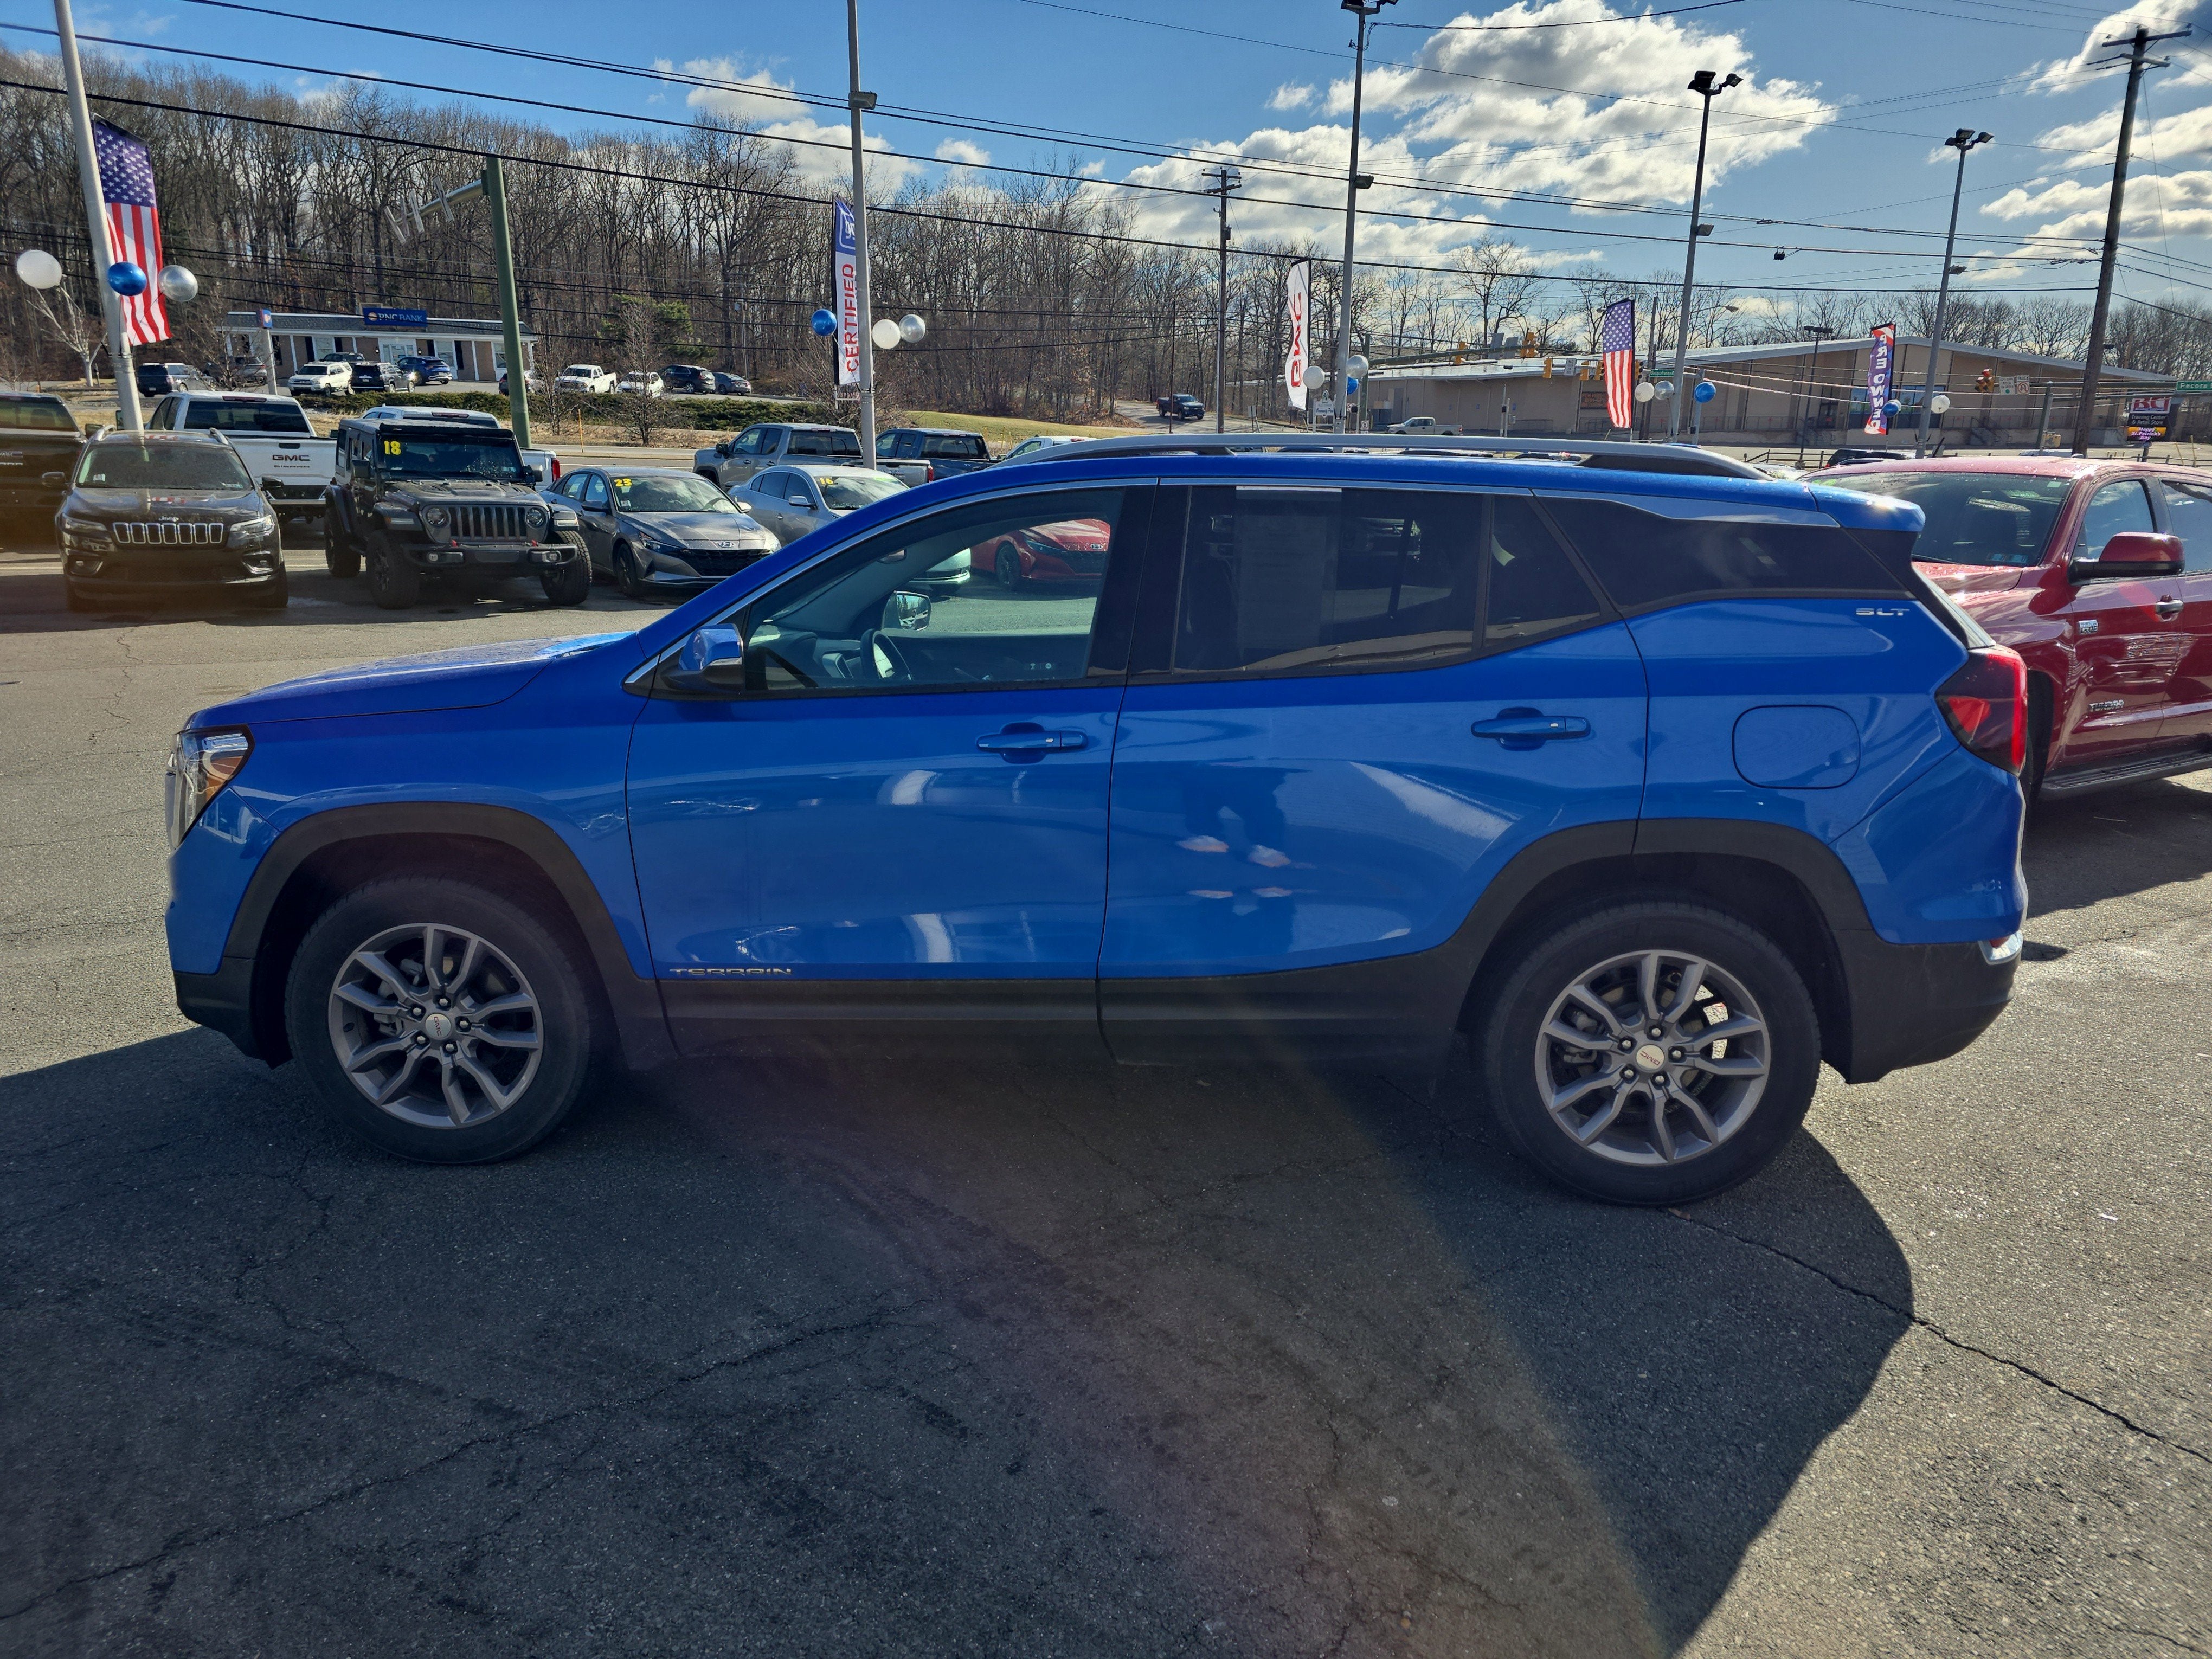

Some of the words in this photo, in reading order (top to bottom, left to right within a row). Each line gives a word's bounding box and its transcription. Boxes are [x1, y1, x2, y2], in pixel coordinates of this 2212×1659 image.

[378, 313, 398, 321] PNC
[398, 314, 423, 322] BANK
[841, 263, 859, 372] CERTIFIED
[384, 440, 401, 455] 18
[614, 478, 633, 487] 23
[820, 477, 834, 485] 16
[1855, 607, 1911, 616] SLT
[2089, 699, 2125, 712] TUNDRA
[669, 968, 792, 976] TERRAIN
[434, 1016, 442, 1037] GMC
[1639, 1050, 1661, 1066] GMC
